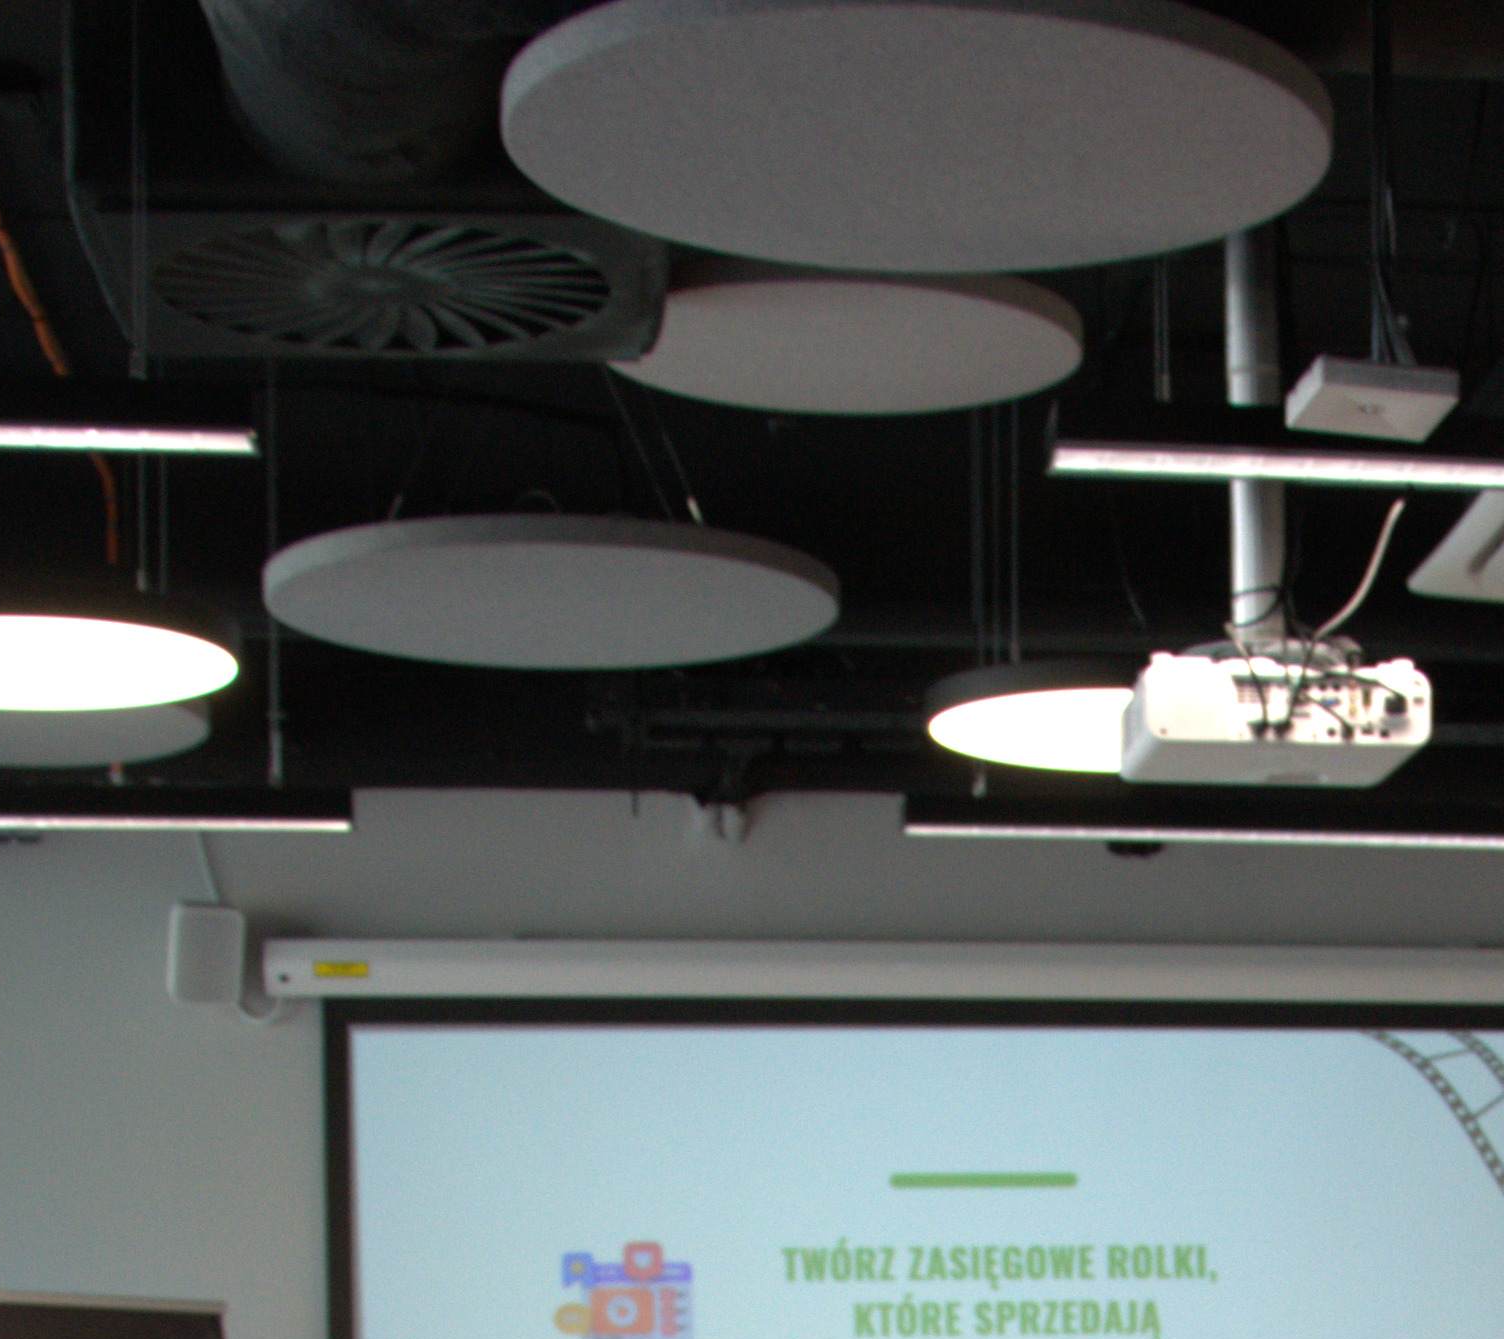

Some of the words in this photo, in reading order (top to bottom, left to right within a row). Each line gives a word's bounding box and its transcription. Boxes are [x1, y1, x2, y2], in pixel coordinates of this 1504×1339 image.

[781, 1237, 896, 1283] TWÓRZ
[908, 1244, 1094, 1290] ZASIĘGOWE
[1107, 1243, 1218, 1283] ROLKI,
[853, 1292, 962, 1338] KTÓRE
